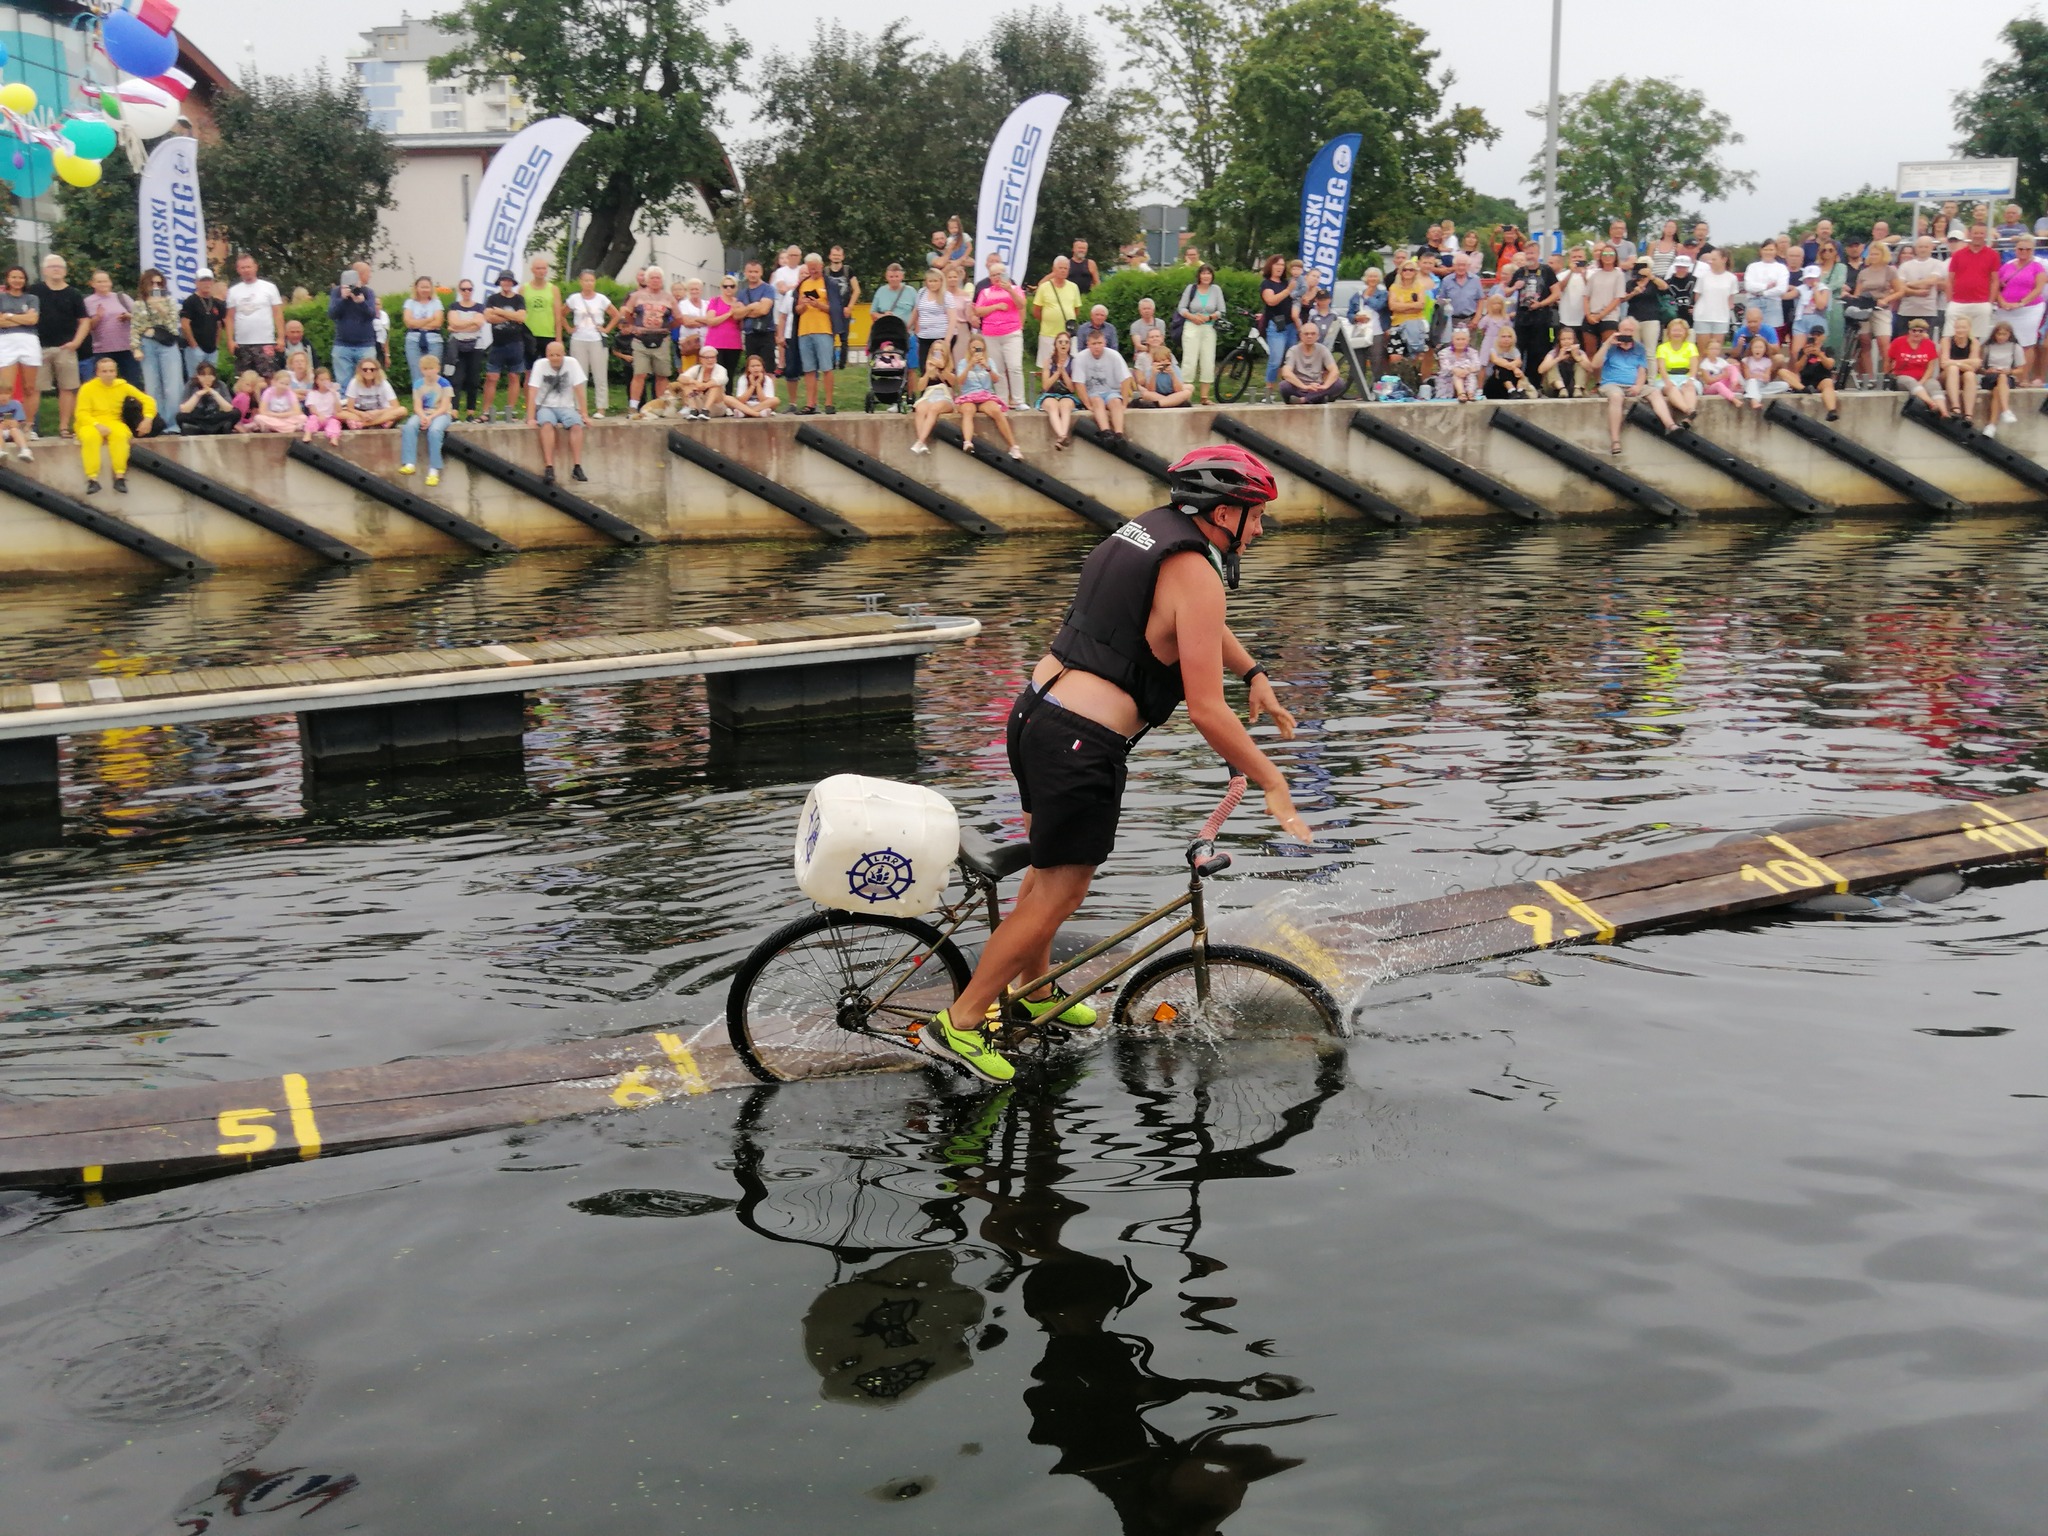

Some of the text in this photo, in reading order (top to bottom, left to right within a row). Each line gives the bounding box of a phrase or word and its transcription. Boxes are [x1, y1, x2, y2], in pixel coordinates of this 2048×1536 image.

[987, 123, 1042, 267] olferries
[171, 182, 198, 303] OBRZEG
[1317, 176, 1348, 292] OBRZEG
[874, 855, 899, 865] LMR
[1741, 860, 1824, 893] 10
[609, 1065, 662, 1107] 6
[216, 1107, 277, 1154] 5
